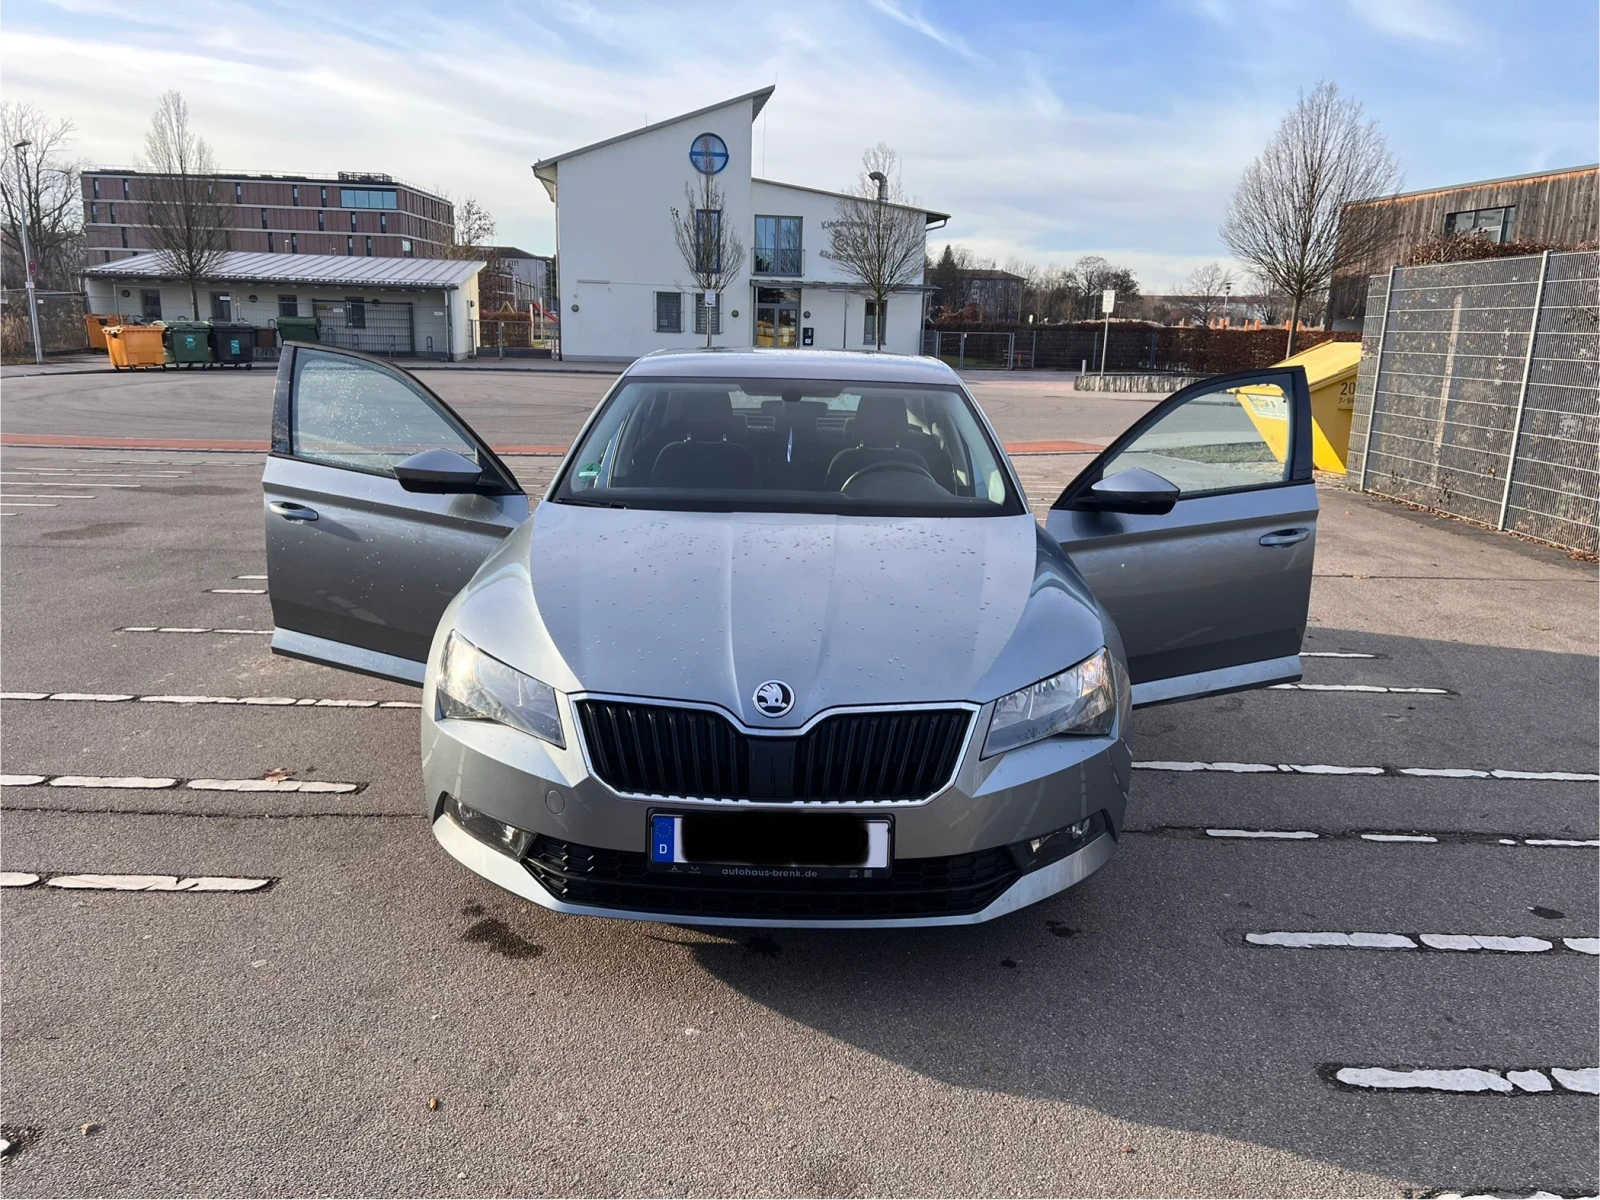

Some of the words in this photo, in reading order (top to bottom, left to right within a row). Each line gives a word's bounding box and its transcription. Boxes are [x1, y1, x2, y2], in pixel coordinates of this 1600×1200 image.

[1340, 382, 1356, 396] 20
[659, 844, 667, 854] D
[721, 867, 818, 878] autohaus-brenk.de
